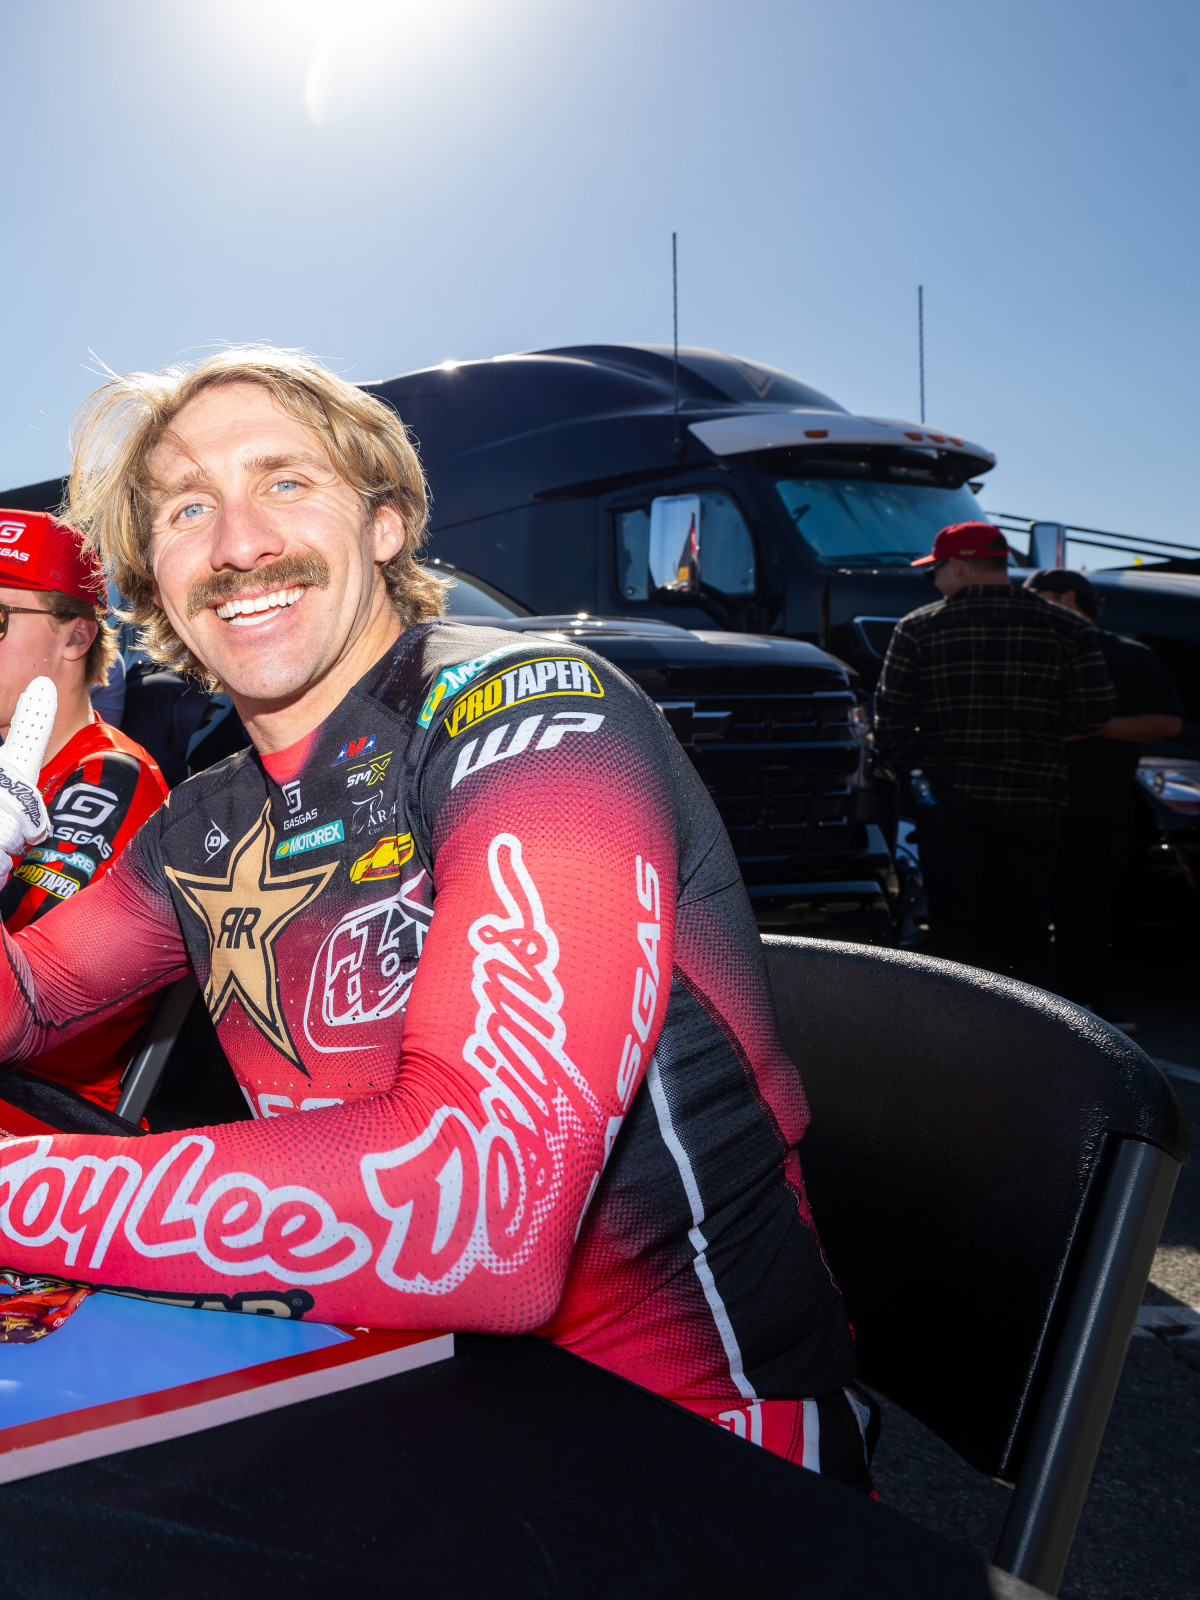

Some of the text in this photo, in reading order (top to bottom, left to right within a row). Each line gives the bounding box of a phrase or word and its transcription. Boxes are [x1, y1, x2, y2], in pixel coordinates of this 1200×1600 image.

[450, 660, 593, 734] PROTAPER
[332, 733, 377, 765] AMA
[346, 757, 391, 789] SMX
[283, 808, 318, 831] GASGAS
[49, 826, 115, 862] SGAS
[289, 823, 343, 853] MOTOREX
[17, 864, 79, 898] PROTAPER
[124, 1134, 372, 1287] Lee
[360, 833, 576, 1296] Designs
